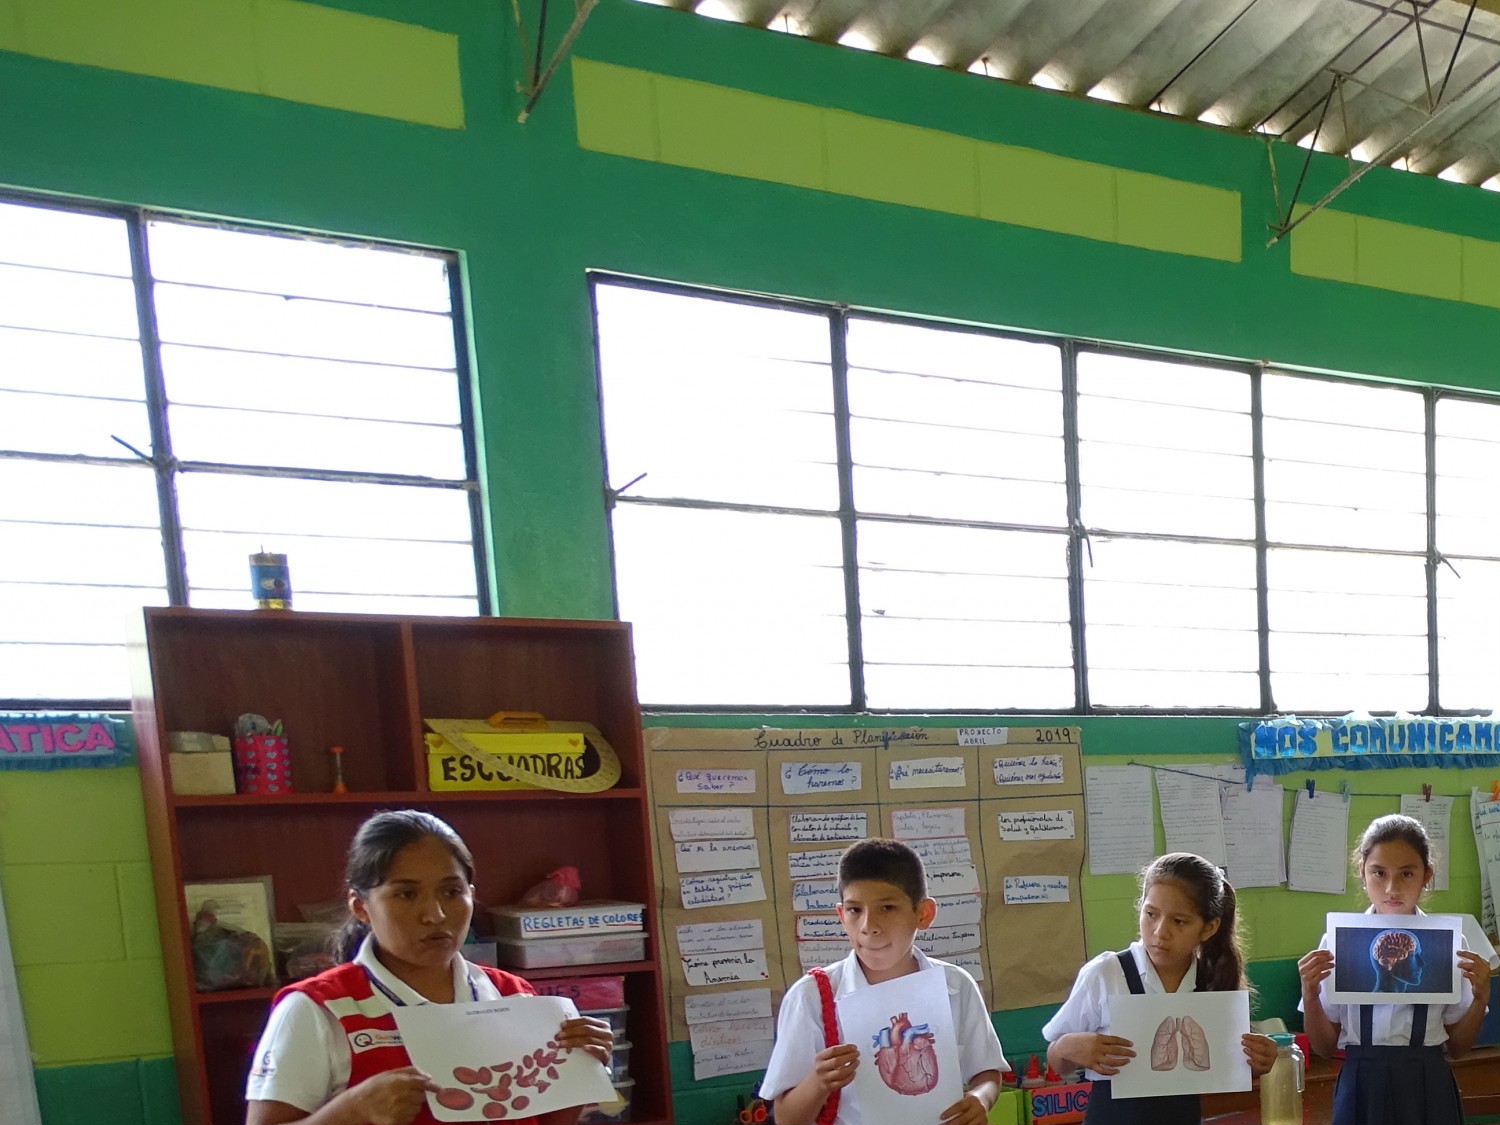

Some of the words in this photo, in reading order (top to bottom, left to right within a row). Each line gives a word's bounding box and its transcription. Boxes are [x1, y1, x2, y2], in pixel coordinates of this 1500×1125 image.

[754, 730, 822, 748] Cuadro
[831, 731, 845, 746] de
[959, 728, 1002, 736] PROYECTO
[1035, 728, 1071, 743] 2019
[963, 737, 988, 745] ABRIL
[1254, 724, 1317, 758] NOS
[797, 763, 831, 776] Cómo
[840, 764, 853, 775] lo
[806, 776, 845, 788] haremos
[523, 916, 585, 930] REGLETAS
[588, 916, 600, 925] DE
[602, 912, 645, 924] COLORES
[1032, 1089, 1093, 1118] SILIC
